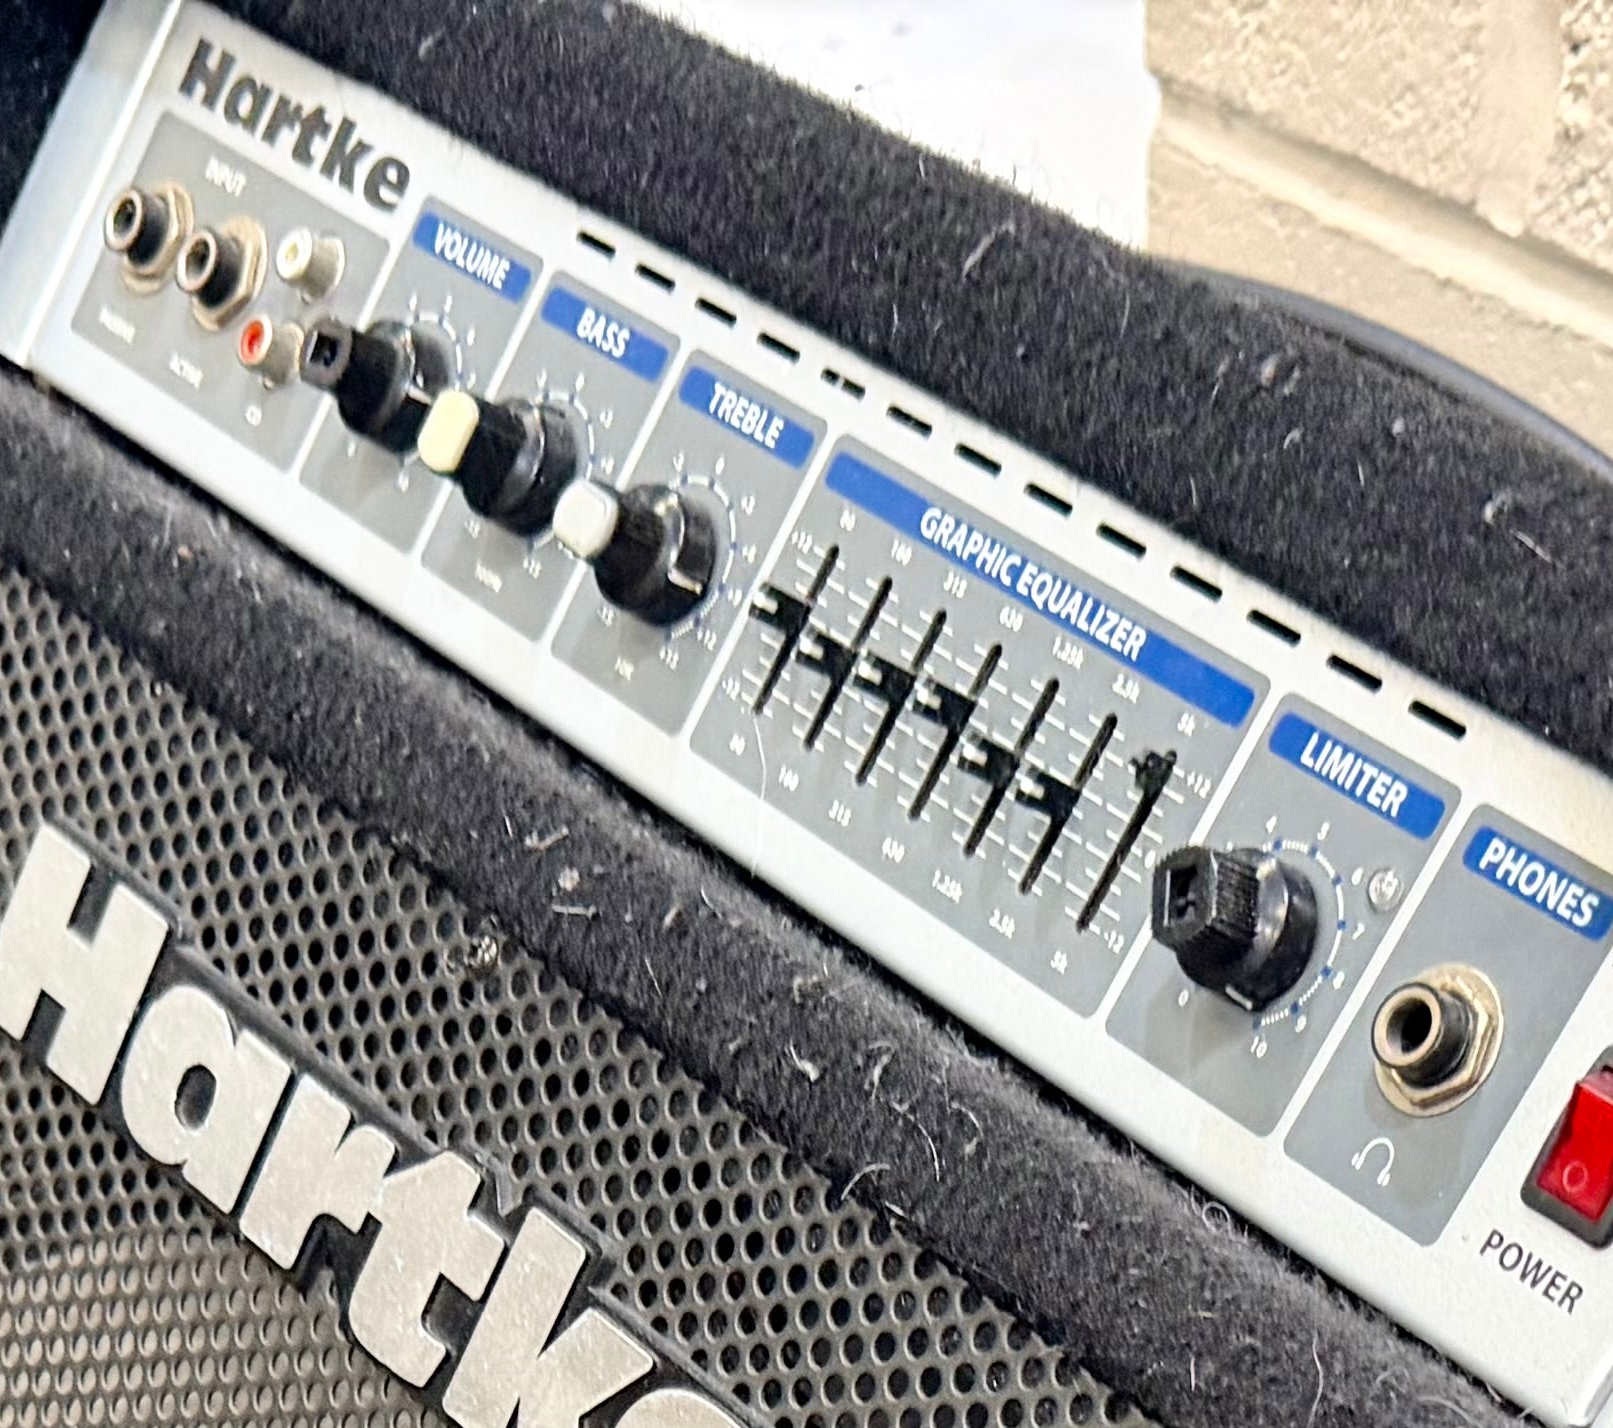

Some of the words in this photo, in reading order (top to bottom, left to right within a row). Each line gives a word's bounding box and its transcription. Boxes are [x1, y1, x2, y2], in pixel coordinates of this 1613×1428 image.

[177, 34, 411, 214] Hartke
[434, 220, 510, 290] VOLUME
[576, 307, 630, 358] BASS
[708, 381, 784, 450] TREBLE
[920, 506, 1022, 588] GRAPHIC
[1015, 560, 1147, 662] EQUALIZER
[1299, 730, 1409, 819] LIMITER
[1478, 836, 1600, 928] PHONES
[1250, 1035, 1268, 1059] 10
[1478, 1228, 1584, 1315] POWER
